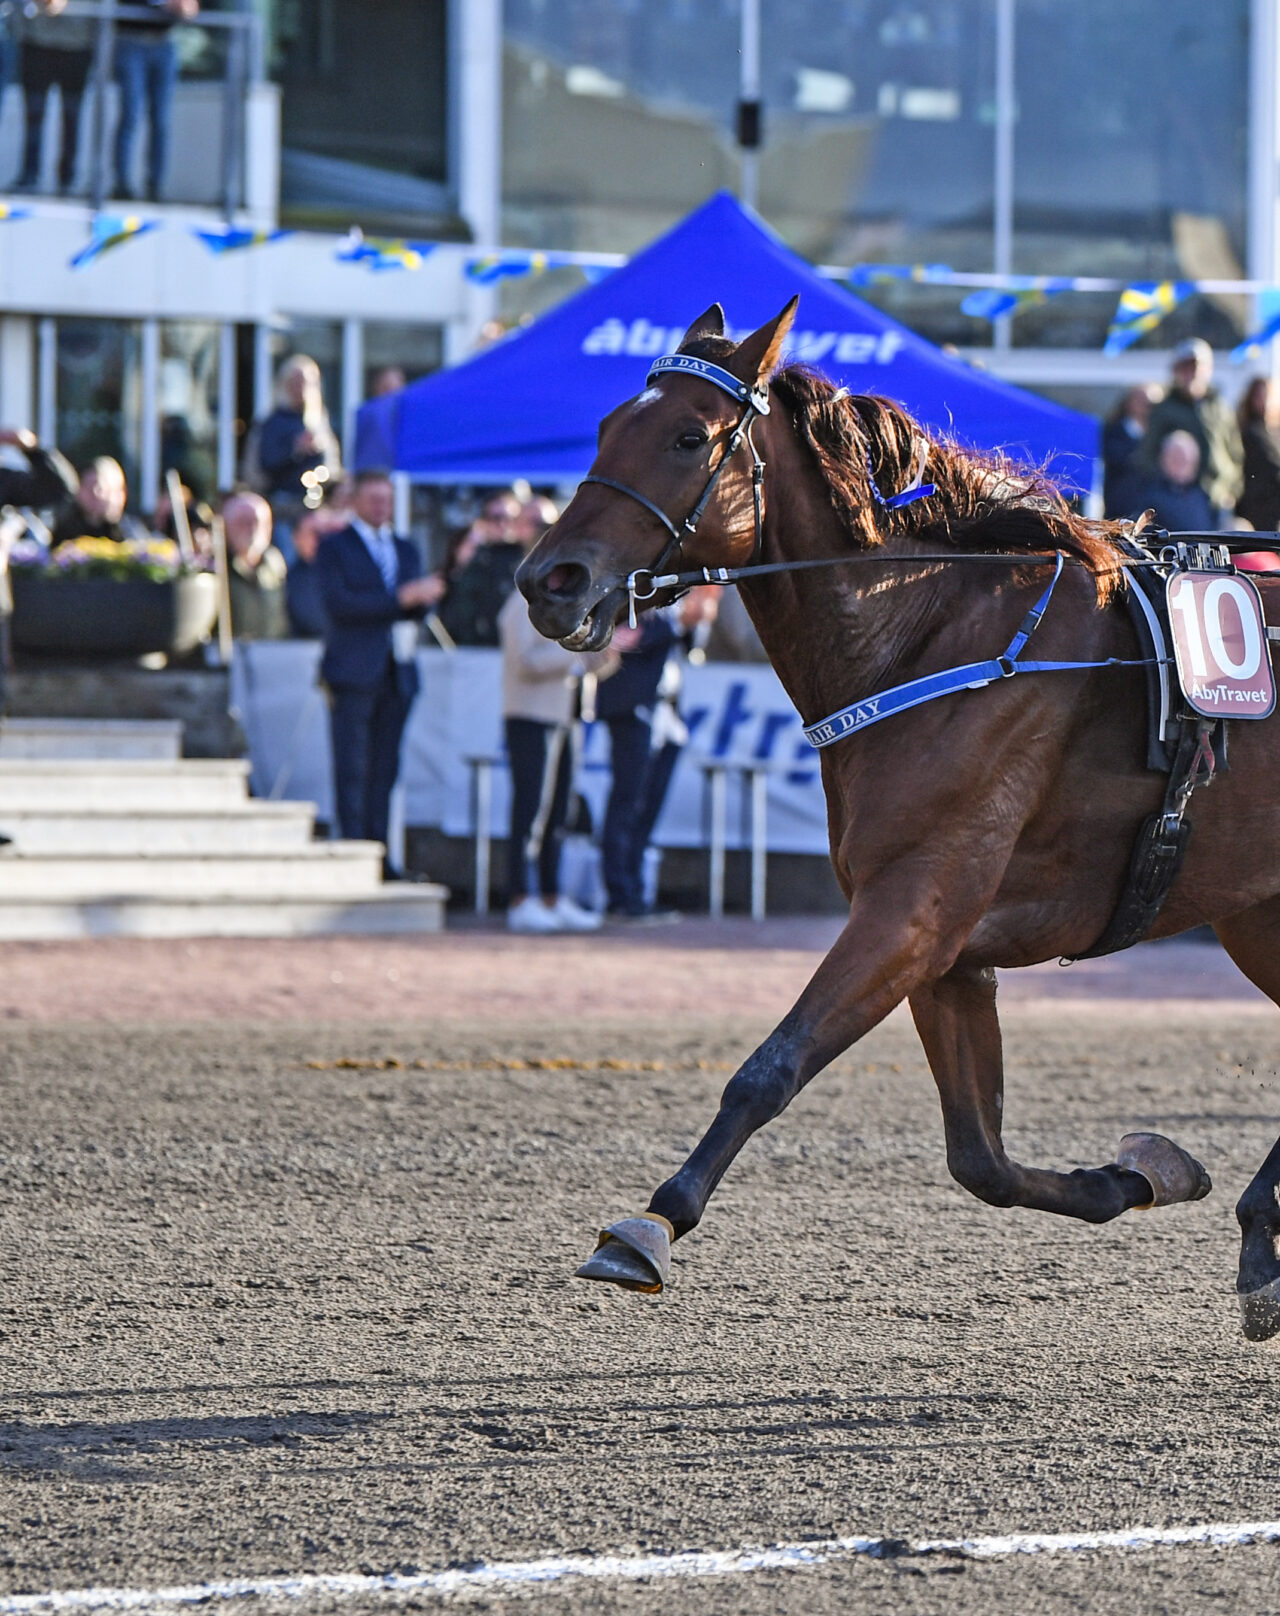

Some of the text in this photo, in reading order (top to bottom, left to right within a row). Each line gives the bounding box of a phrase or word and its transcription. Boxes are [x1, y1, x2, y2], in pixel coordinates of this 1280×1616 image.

[677, 359, 711, 373] DAY
[1172, 578, 1261, 680] 10
[1192, 679, 1268, 704] ÅbyTravet
[839, 699, 880, 730] DAY
